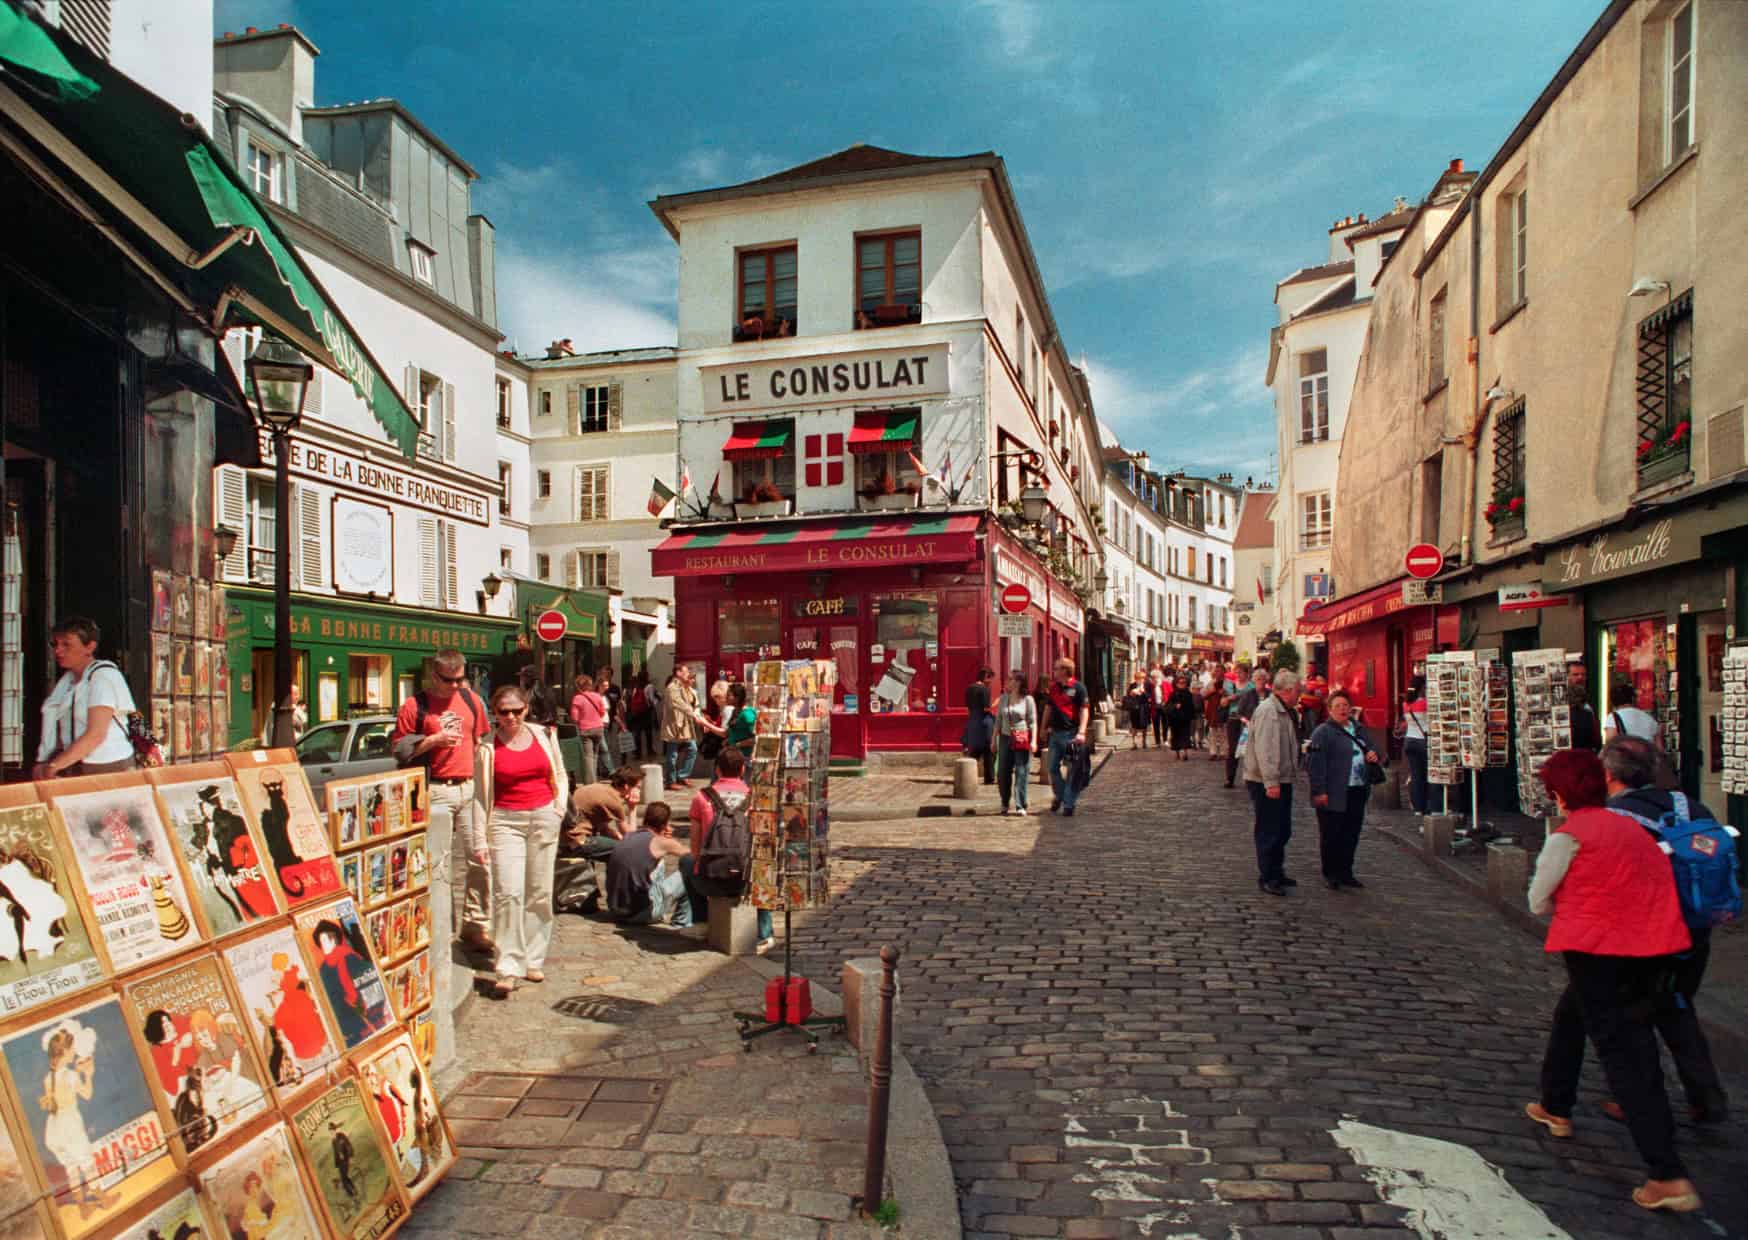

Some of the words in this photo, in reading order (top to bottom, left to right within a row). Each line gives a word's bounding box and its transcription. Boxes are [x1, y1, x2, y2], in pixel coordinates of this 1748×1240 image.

[720, 373, 750, 402] LE
[770, 356, 929, 399] CONSULAT
[307, 449, 328, 474] DE
[332, 456, 353, 482] LA
[358, 464, 404, 496] BONNE
[407, 481, 483, 518] FRANQUETTE
[686, 553, 767, 569] RESTAURANT
[807, 548, 829, 564] LE
[839, 542, 936, 561] CONSULAT
[1560, 547, 1581, 583] La
[806, 598, 845, 616] CAFÉ
[1505, 592, 1528, 601] AGFA
[320, 617, 382, 641] BONNE
[388, 625, 488, 650] FRANQUETTE
[91, 1119, 161, 1176] MAGGI
